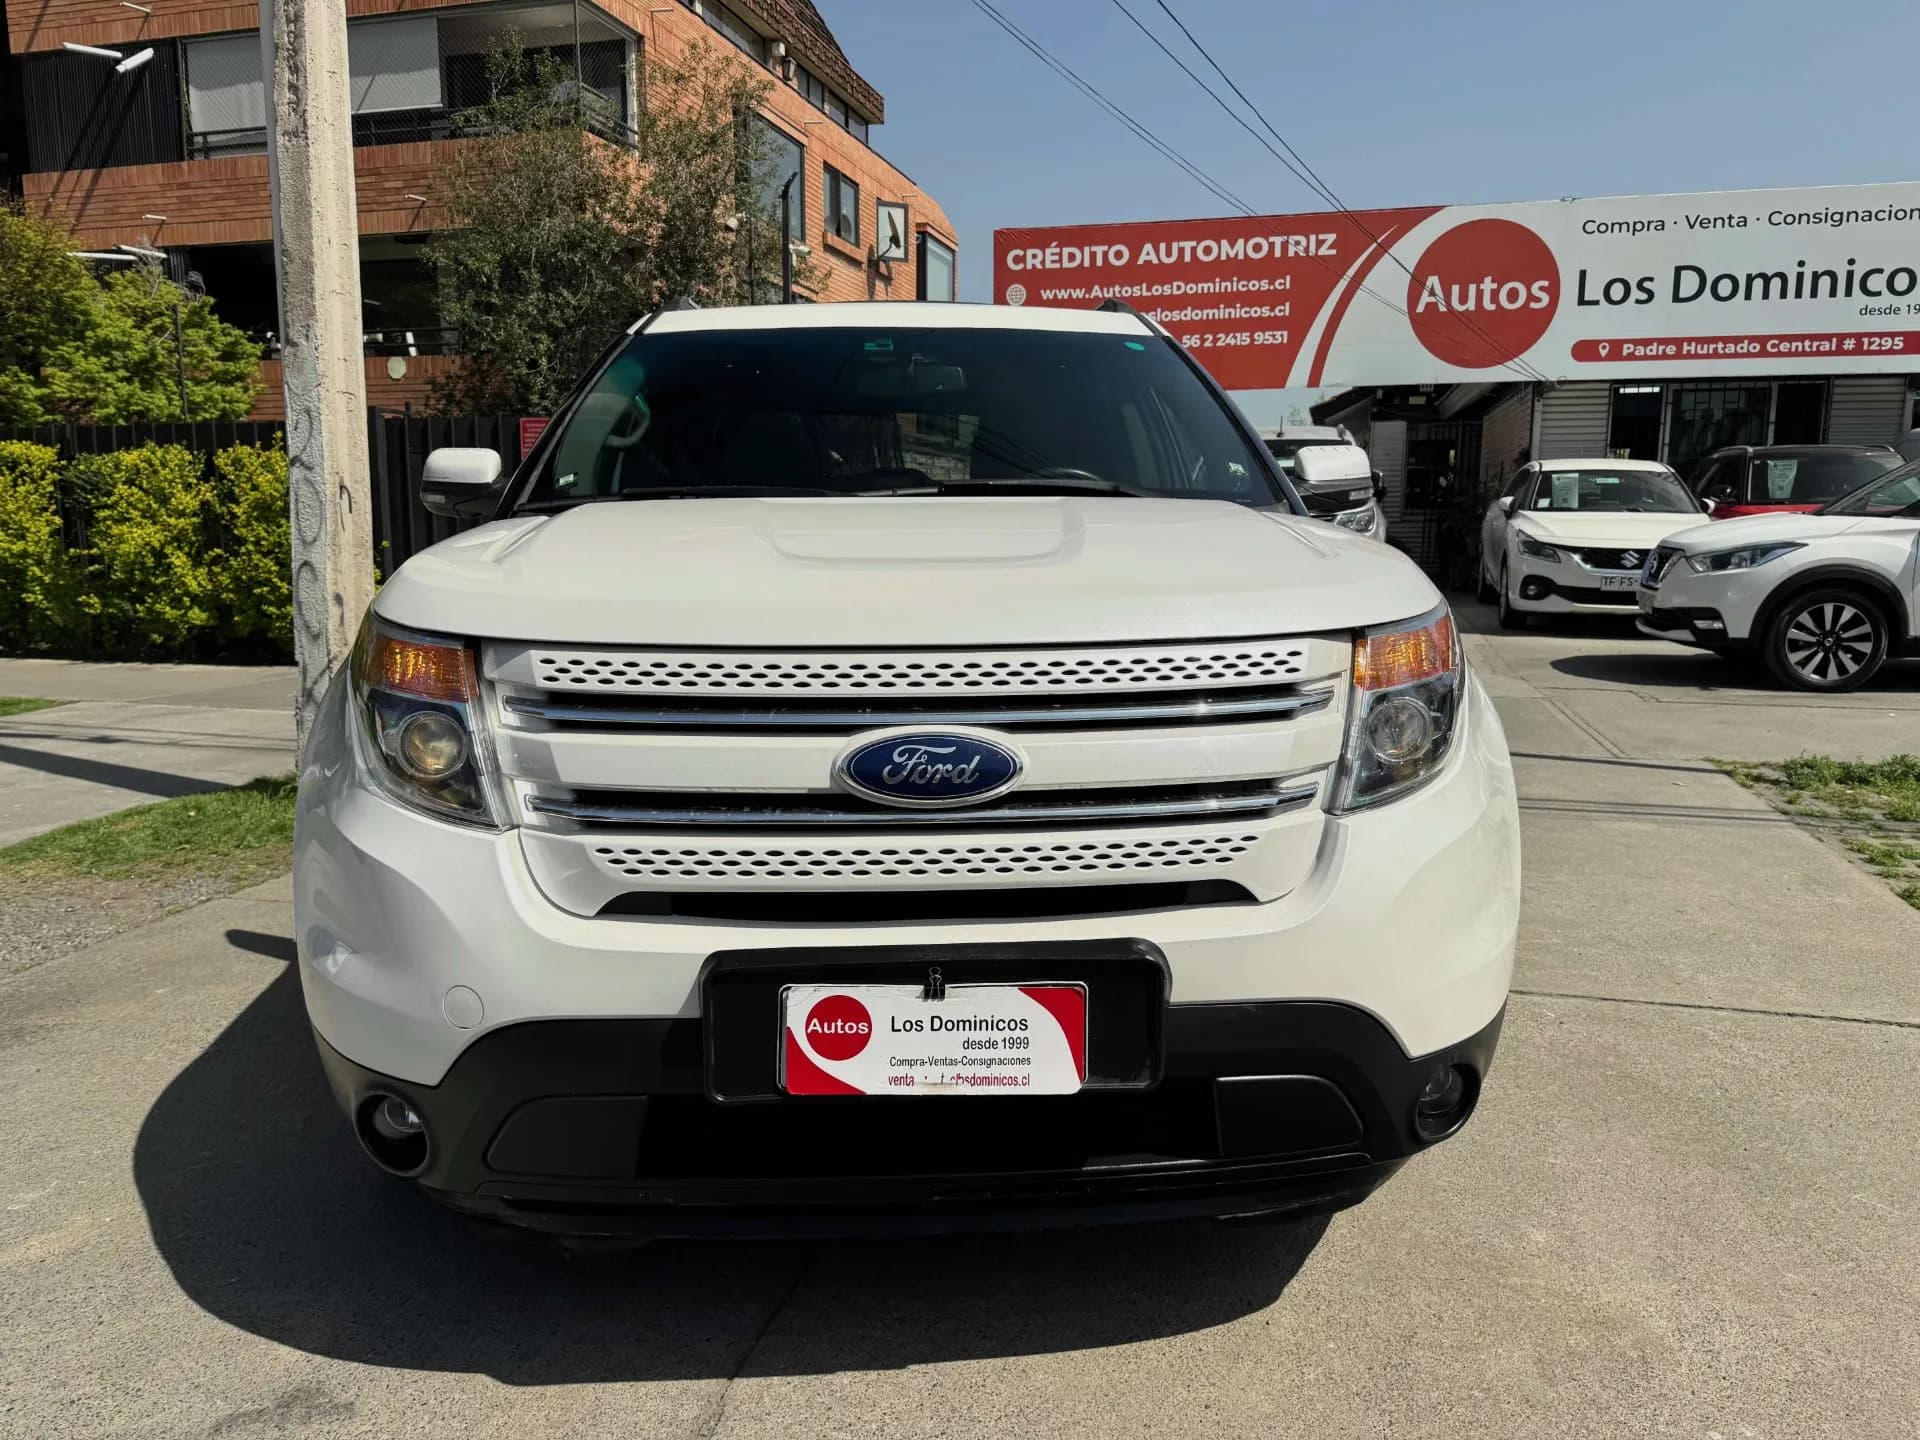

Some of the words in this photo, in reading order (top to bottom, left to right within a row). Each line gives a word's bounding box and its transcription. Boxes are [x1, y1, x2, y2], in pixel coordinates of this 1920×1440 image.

[1582, 219, 1666, 236] Compra
[1685, 214, 1748, 230] Venta
[1767, 204, 1920, 228] Consignacion
[1006, 241, 1130, 271] CRÉDITO
[1136, 233, 1337, 265] AUTOMOTRIZ
[1040, 275, 1291, 300] www.AutosLosDominicos.cl
[1576, 268, 1656, 307] Los
[1671, 257, 1918, 304] Dominico
[1415, 275, 1550, 313] Autos
[1139, 302, 1290, 322] slosdominicos.cl
[1859, 303, 1901, 316] desde
[1182, 334, 1201, 349] 56
[1203, 334, 1213, 347] 2
[1215, 332, 1251, 347] 2415
[1254, 331, 1288, 345] 9531
[1622, 342, 1677, 358] Padre
[1682, 339, 1761, 356] Hurtado
[1766, 337, 1837, 354] Central
[1842, 337, 1856, 351] #
[1861, 336, 1905, 351] 1295
[882, 744, 981, 785] Ford
[807, 1017, 870, 1035] Autos
[891, 1015, 924, 1033] Los
[930, 1014, 1029, 1032] Dominicos
[962, 1037, 999, 1051] desde
[1001, 1036, 1030, 1050] 1999
